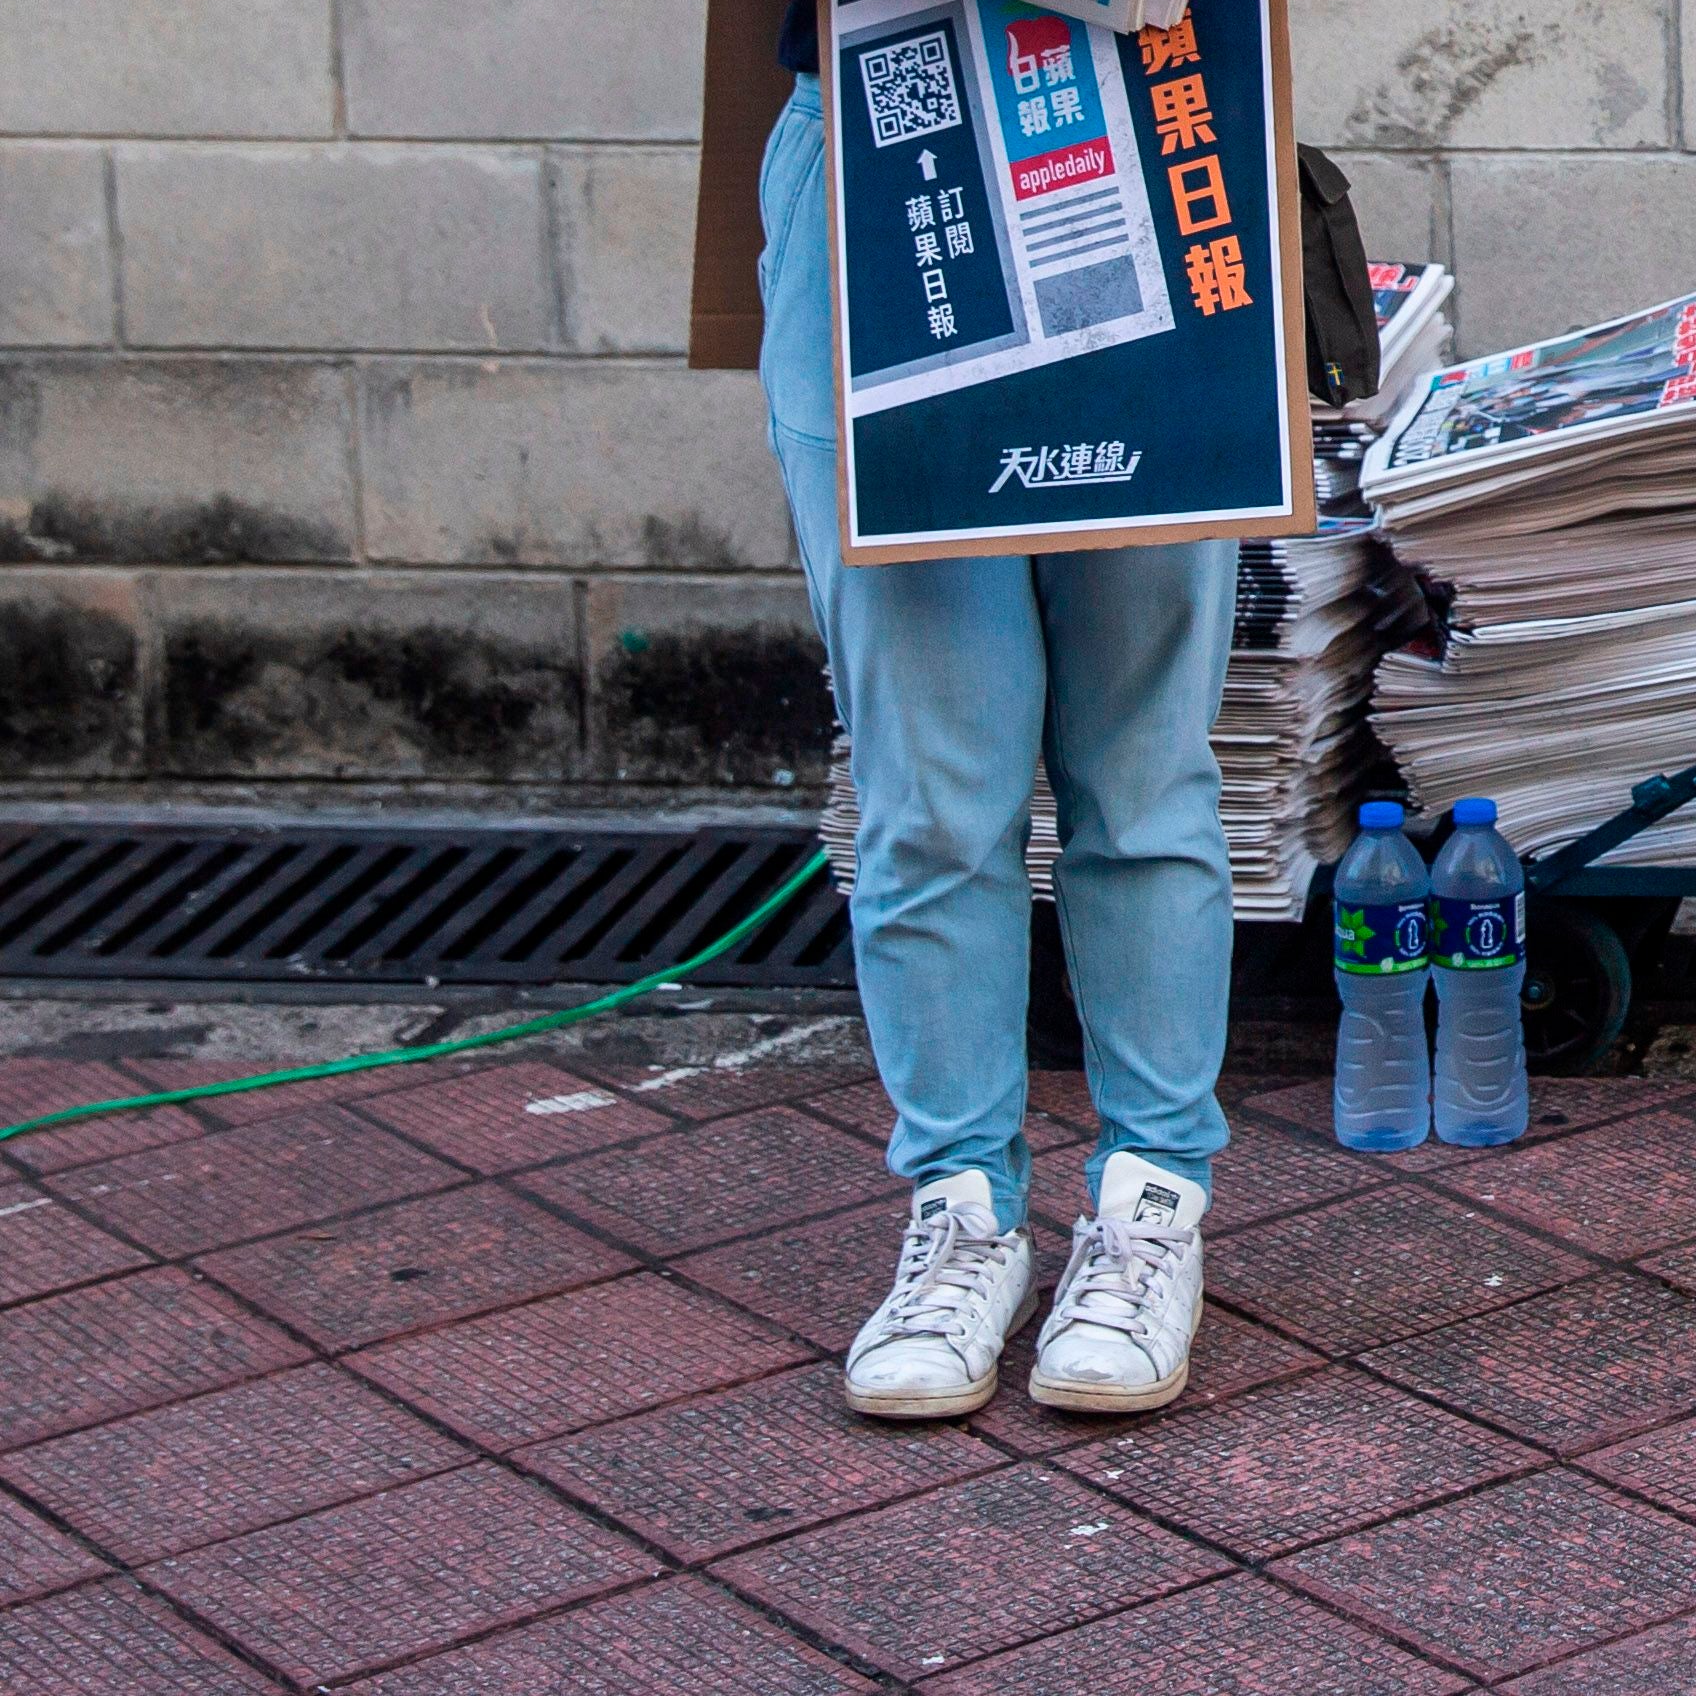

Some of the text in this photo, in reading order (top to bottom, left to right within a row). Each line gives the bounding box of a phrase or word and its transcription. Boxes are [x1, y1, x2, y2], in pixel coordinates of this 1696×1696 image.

[1019, 147, 1106, 194] appledaily
[1136, 7, 1254, 317] 蘋果日報
[936, 186, 975, 260] 訂閱
[904, 194, 959, 340] 蘋果日報
[987, 440, 1143, 494] 天水連線
